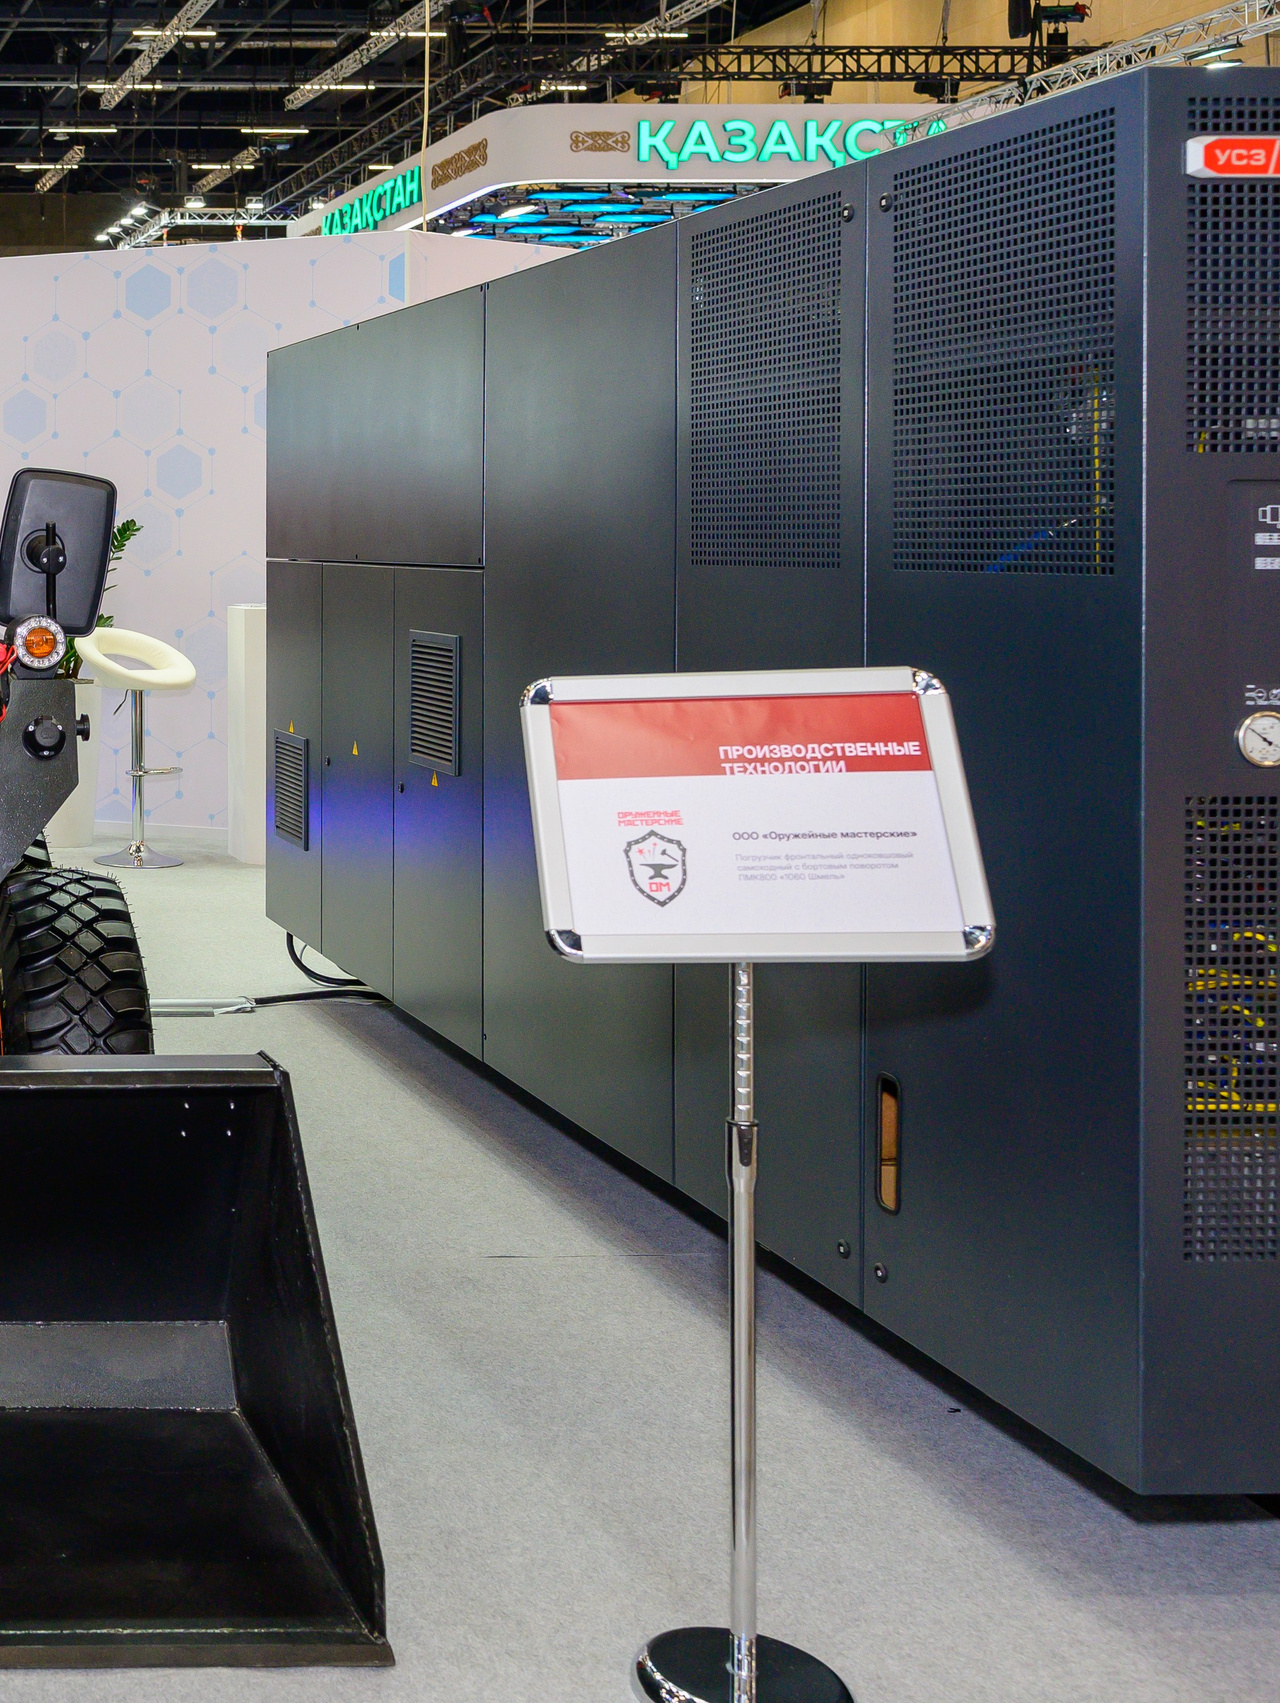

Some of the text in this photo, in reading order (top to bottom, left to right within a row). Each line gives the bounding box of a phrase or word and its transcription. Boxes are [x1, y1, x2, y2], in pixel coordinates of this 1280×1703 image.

[719, 741, 922, 760] ПРОИЗВОДСТВЕННЫЕ
[721, 760, 847, 776] ТЕХНОЛОГИИ
[732, 830, 918, 842] ООО «Оружейные мастерские»
[649, 882, 671, 892] ОМ
